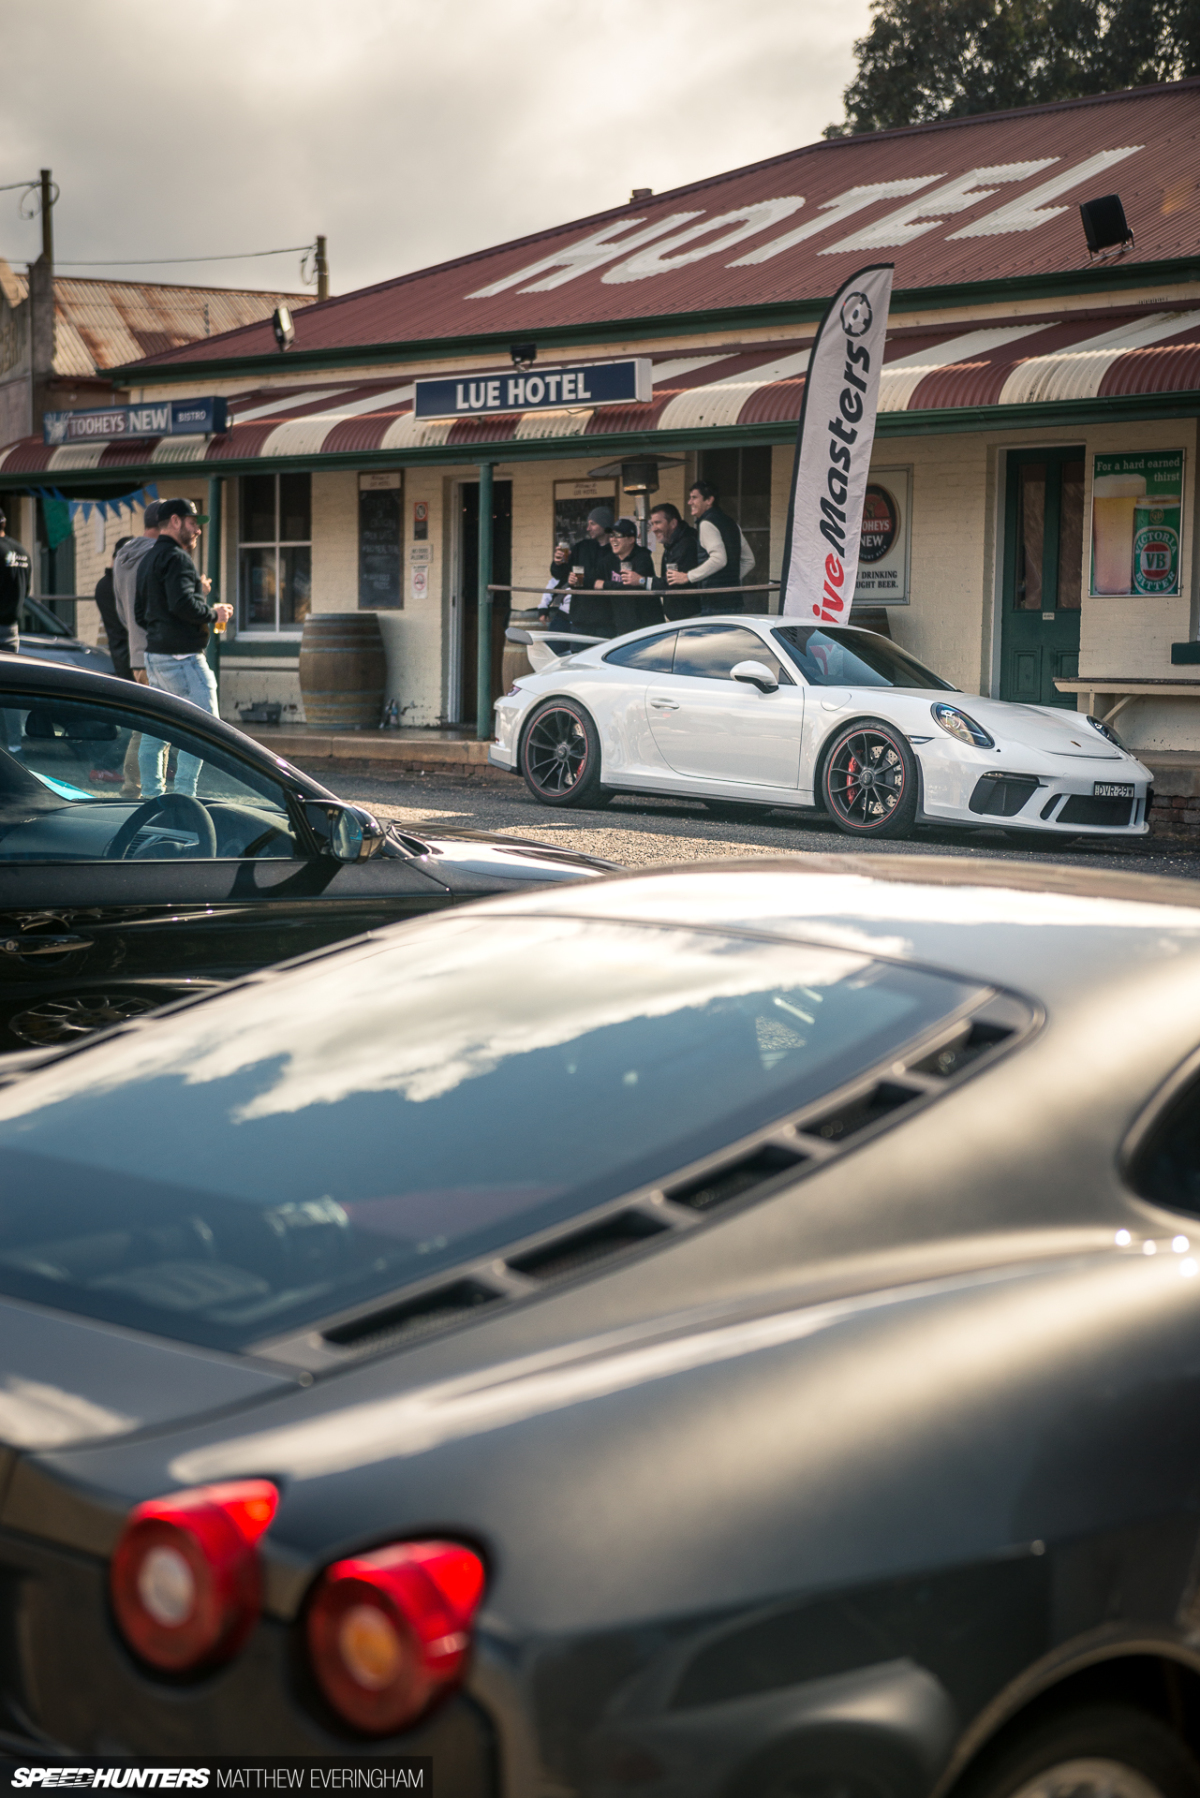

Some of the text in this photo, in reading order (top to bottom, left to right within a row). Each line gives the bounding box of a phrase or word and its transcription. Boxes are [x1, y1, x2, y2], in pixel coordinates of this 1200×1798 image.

[464, 144, 1145, 299] HOTEL
[456, 372, 592, 410] LUE HOTEL
[70, 408, 168, 435] TOOHEYS NEW
[178, 410, 206, 422] BISTRO
[1096, 461, 1112, 471] For
[1123, 459, 1145, 470] hard
[1147, 457, 1180, 468] earned
[812, 338, 870, 623] iveMasters
[1154, 472, 1180, 482] thirst
[861, 520, 890, 532] OHEYS
[860, 534, 884, 547] NEW
[1135, 531, 1177, 555] VICTORIA
[1145, 552, 1167, 570] VB
[861, 570, 898, 579] DRINKING
[1136, 570, 1175, 591] BITTER
[856, 580, 899, 589] UGHT BEER.
